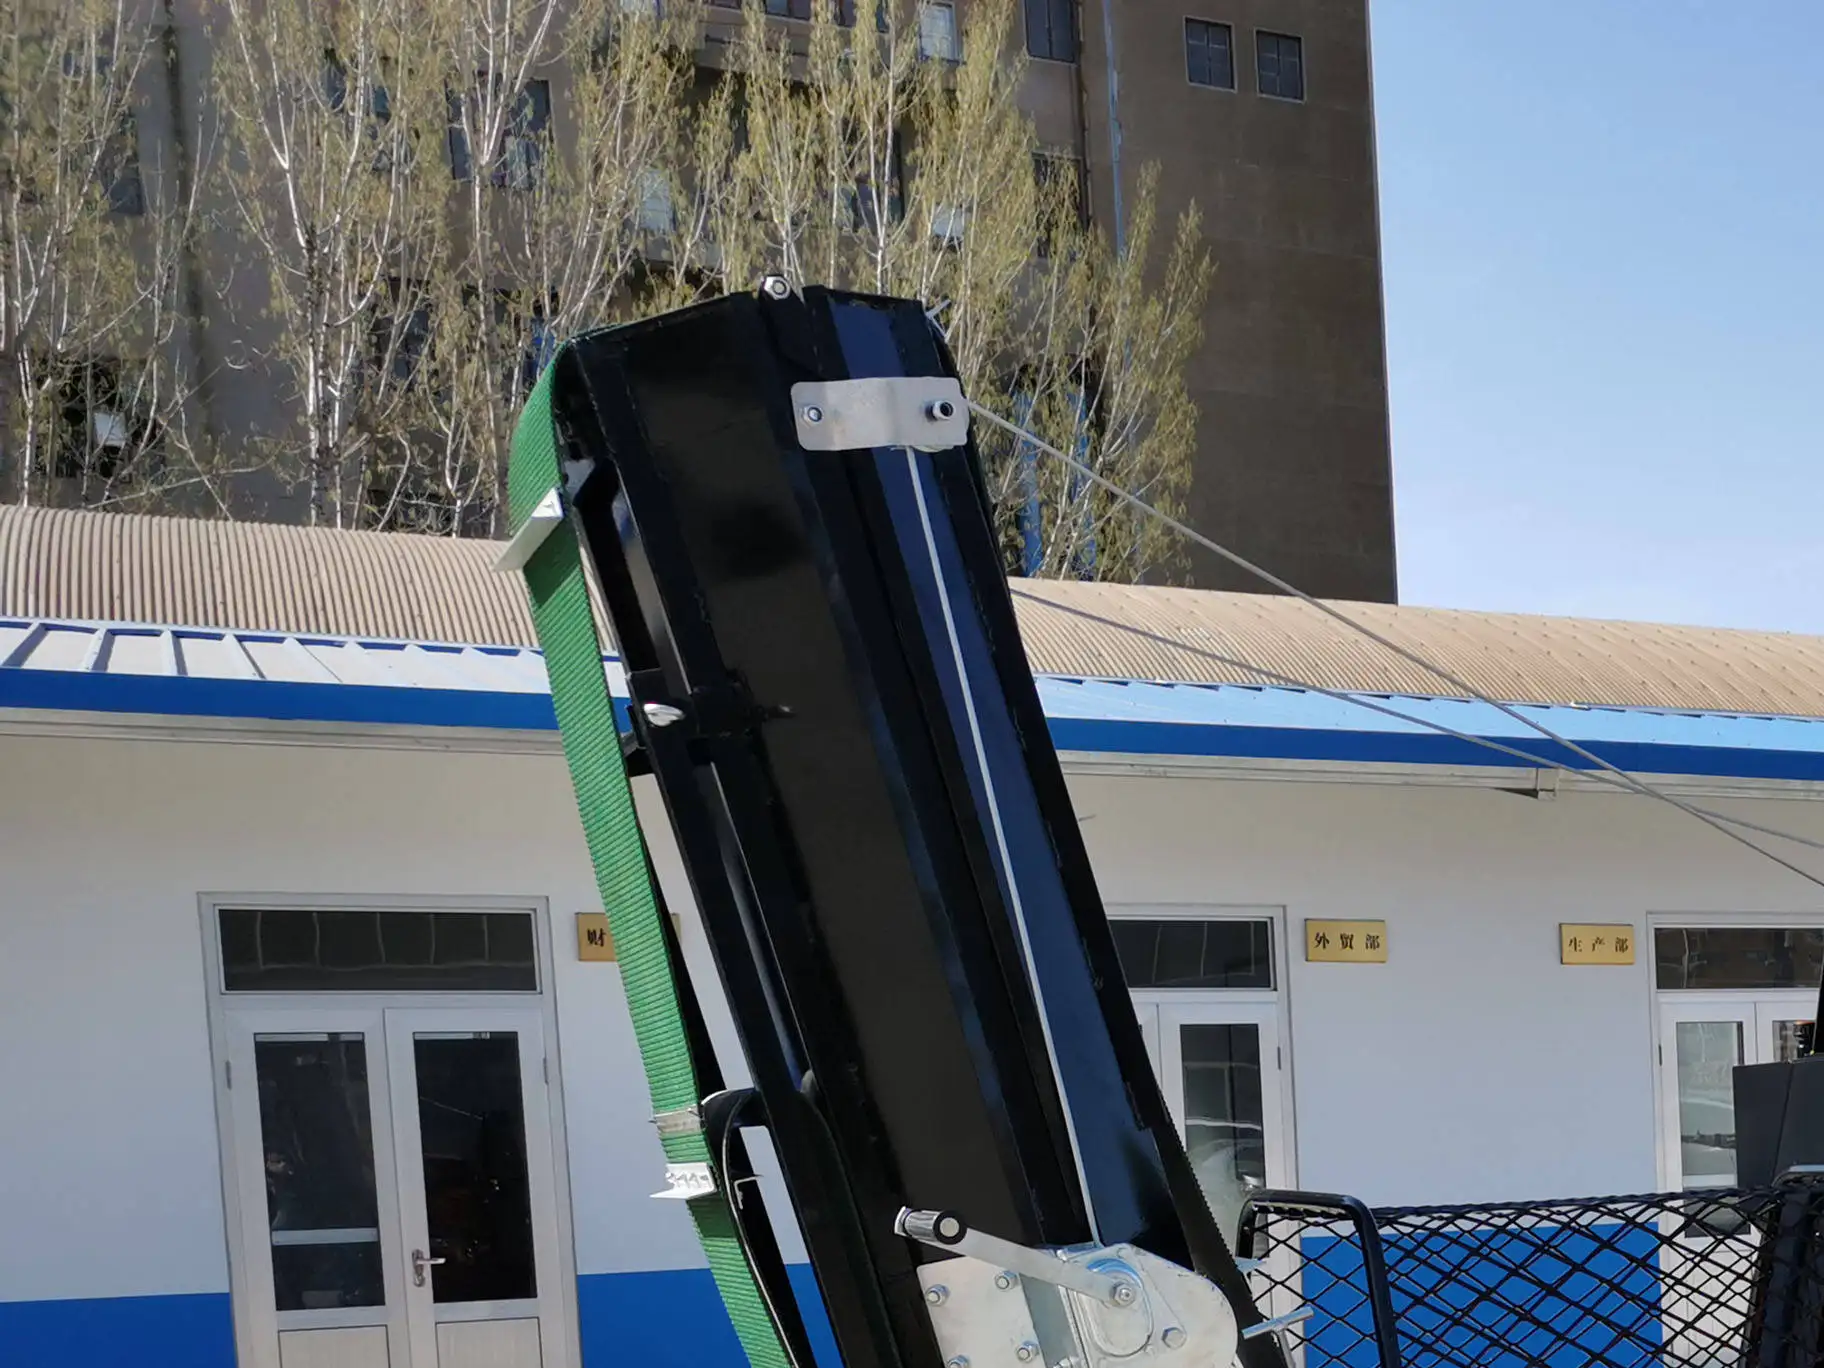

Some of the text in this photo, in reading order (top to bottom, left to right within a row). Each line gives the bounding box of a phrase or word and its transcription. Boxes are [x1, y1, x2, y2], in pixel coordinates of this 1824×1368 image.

[1314, 931, 1380, 951] 外贸部
[1568, 936, 1629, 953] 生产部
